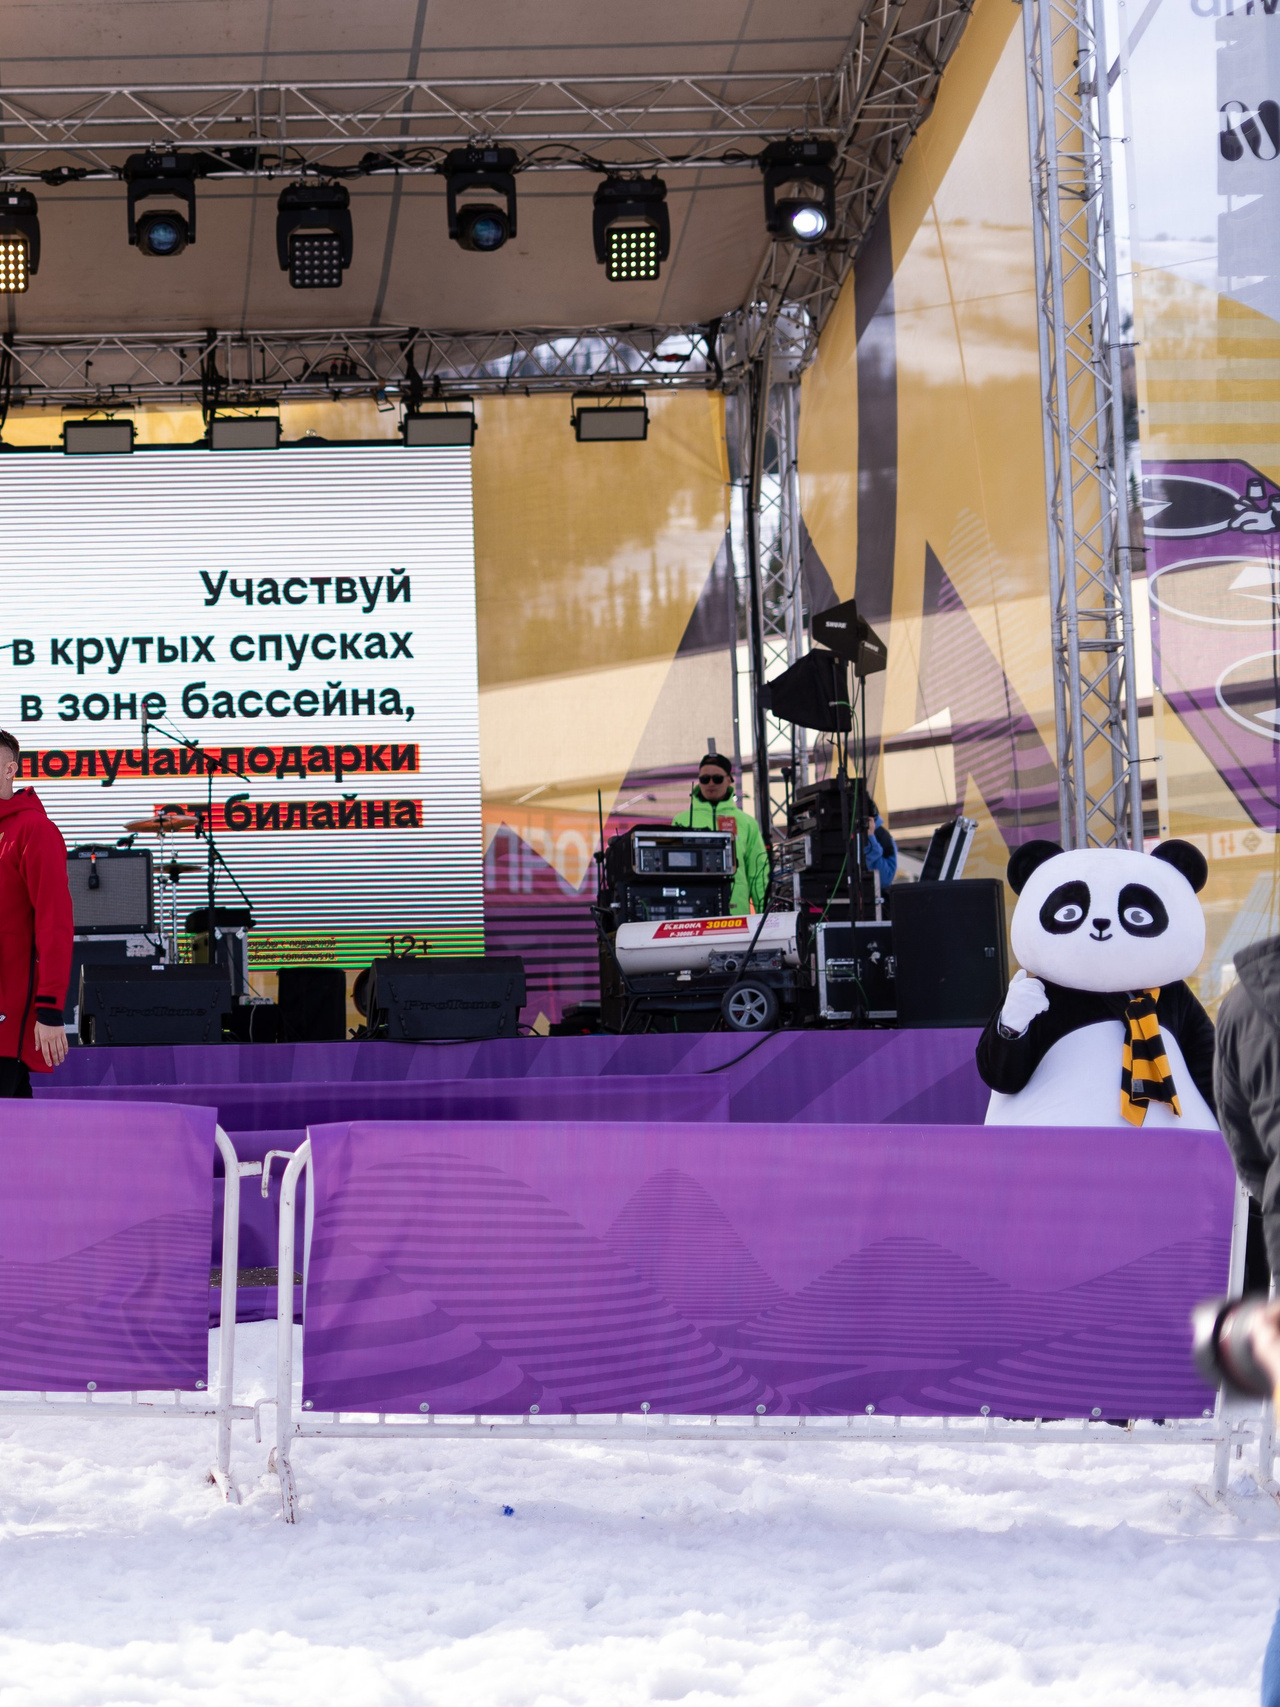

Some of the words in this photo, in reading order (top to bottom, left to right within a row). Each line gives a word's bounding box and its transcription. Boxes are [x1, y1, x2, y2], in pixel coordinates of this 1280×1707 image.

[199, 568, 412, 614] Участвуй
[13, 638, 35, 666] в
[51, 635, 216, 675] крутых
[230, 632, 415, 672] спусках
[20, 694, 44, 722] в
[57, 692, 167, 722] зоне
[182, 681, 415, 723] бассейна,
[14, 740, 206, 788] получай
[220, 743, 417, 783] подарки
[224, 793, 420, 832] билайна
[706, 919, 743, 929] 30000
[384, 934, 433, 959] 12+
